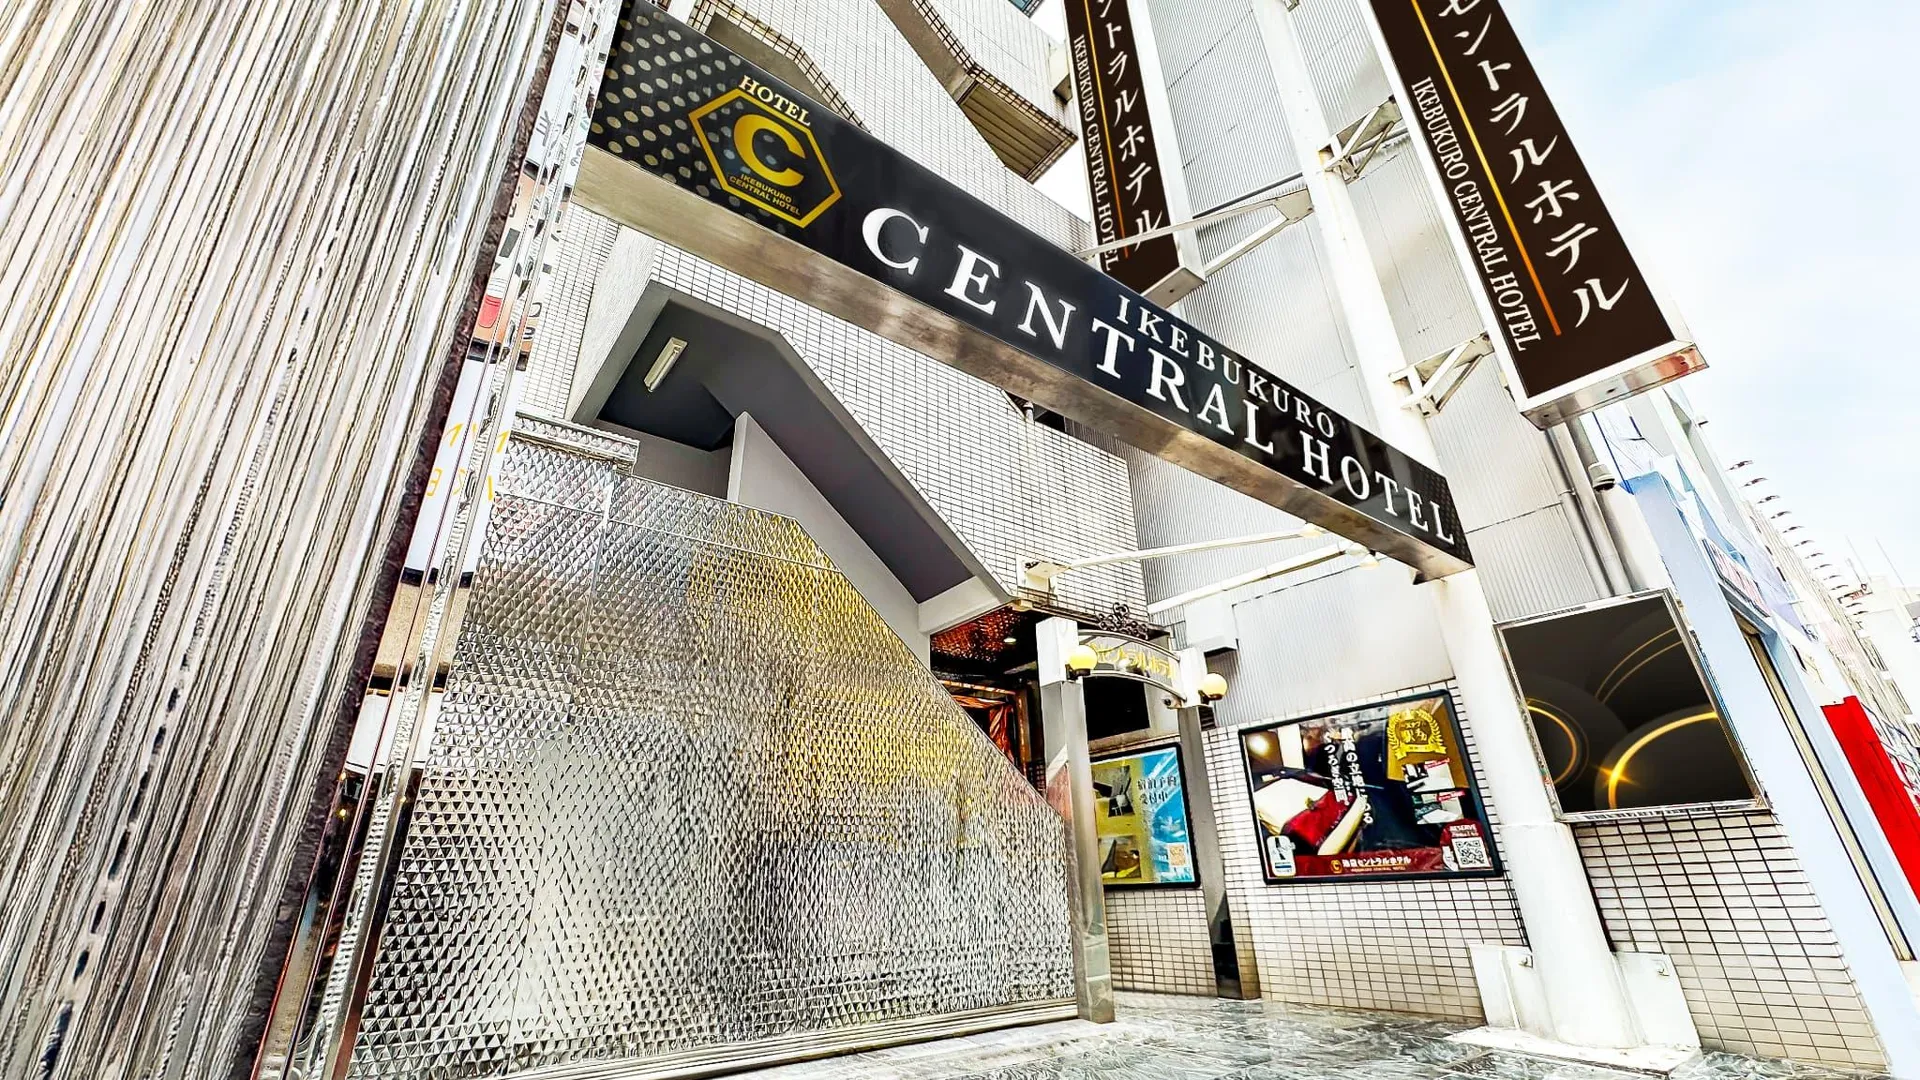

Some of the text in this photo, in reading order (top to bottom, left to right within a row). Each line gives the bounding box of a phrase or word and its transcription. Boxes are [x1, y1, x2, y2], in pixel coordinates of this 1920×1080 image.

[733, 113, 806, 187] C
[738, 75, 811, 126] HOTEL
[1073, 34, 1119, 271] IKEBUKURO CENTRAL HOTEL
[729, 176, 801, 215] CENTRAL HOTEL
[740, 173, 792, 203] IKEBUKURO
[1410, 76, 1542, 352] IKEBUKURO CENTRAL HOTEL
[861, 207, 1455, 545] CENTRAL HOTEL
[1116, 294, 1335, 439] IKEBUKURO
